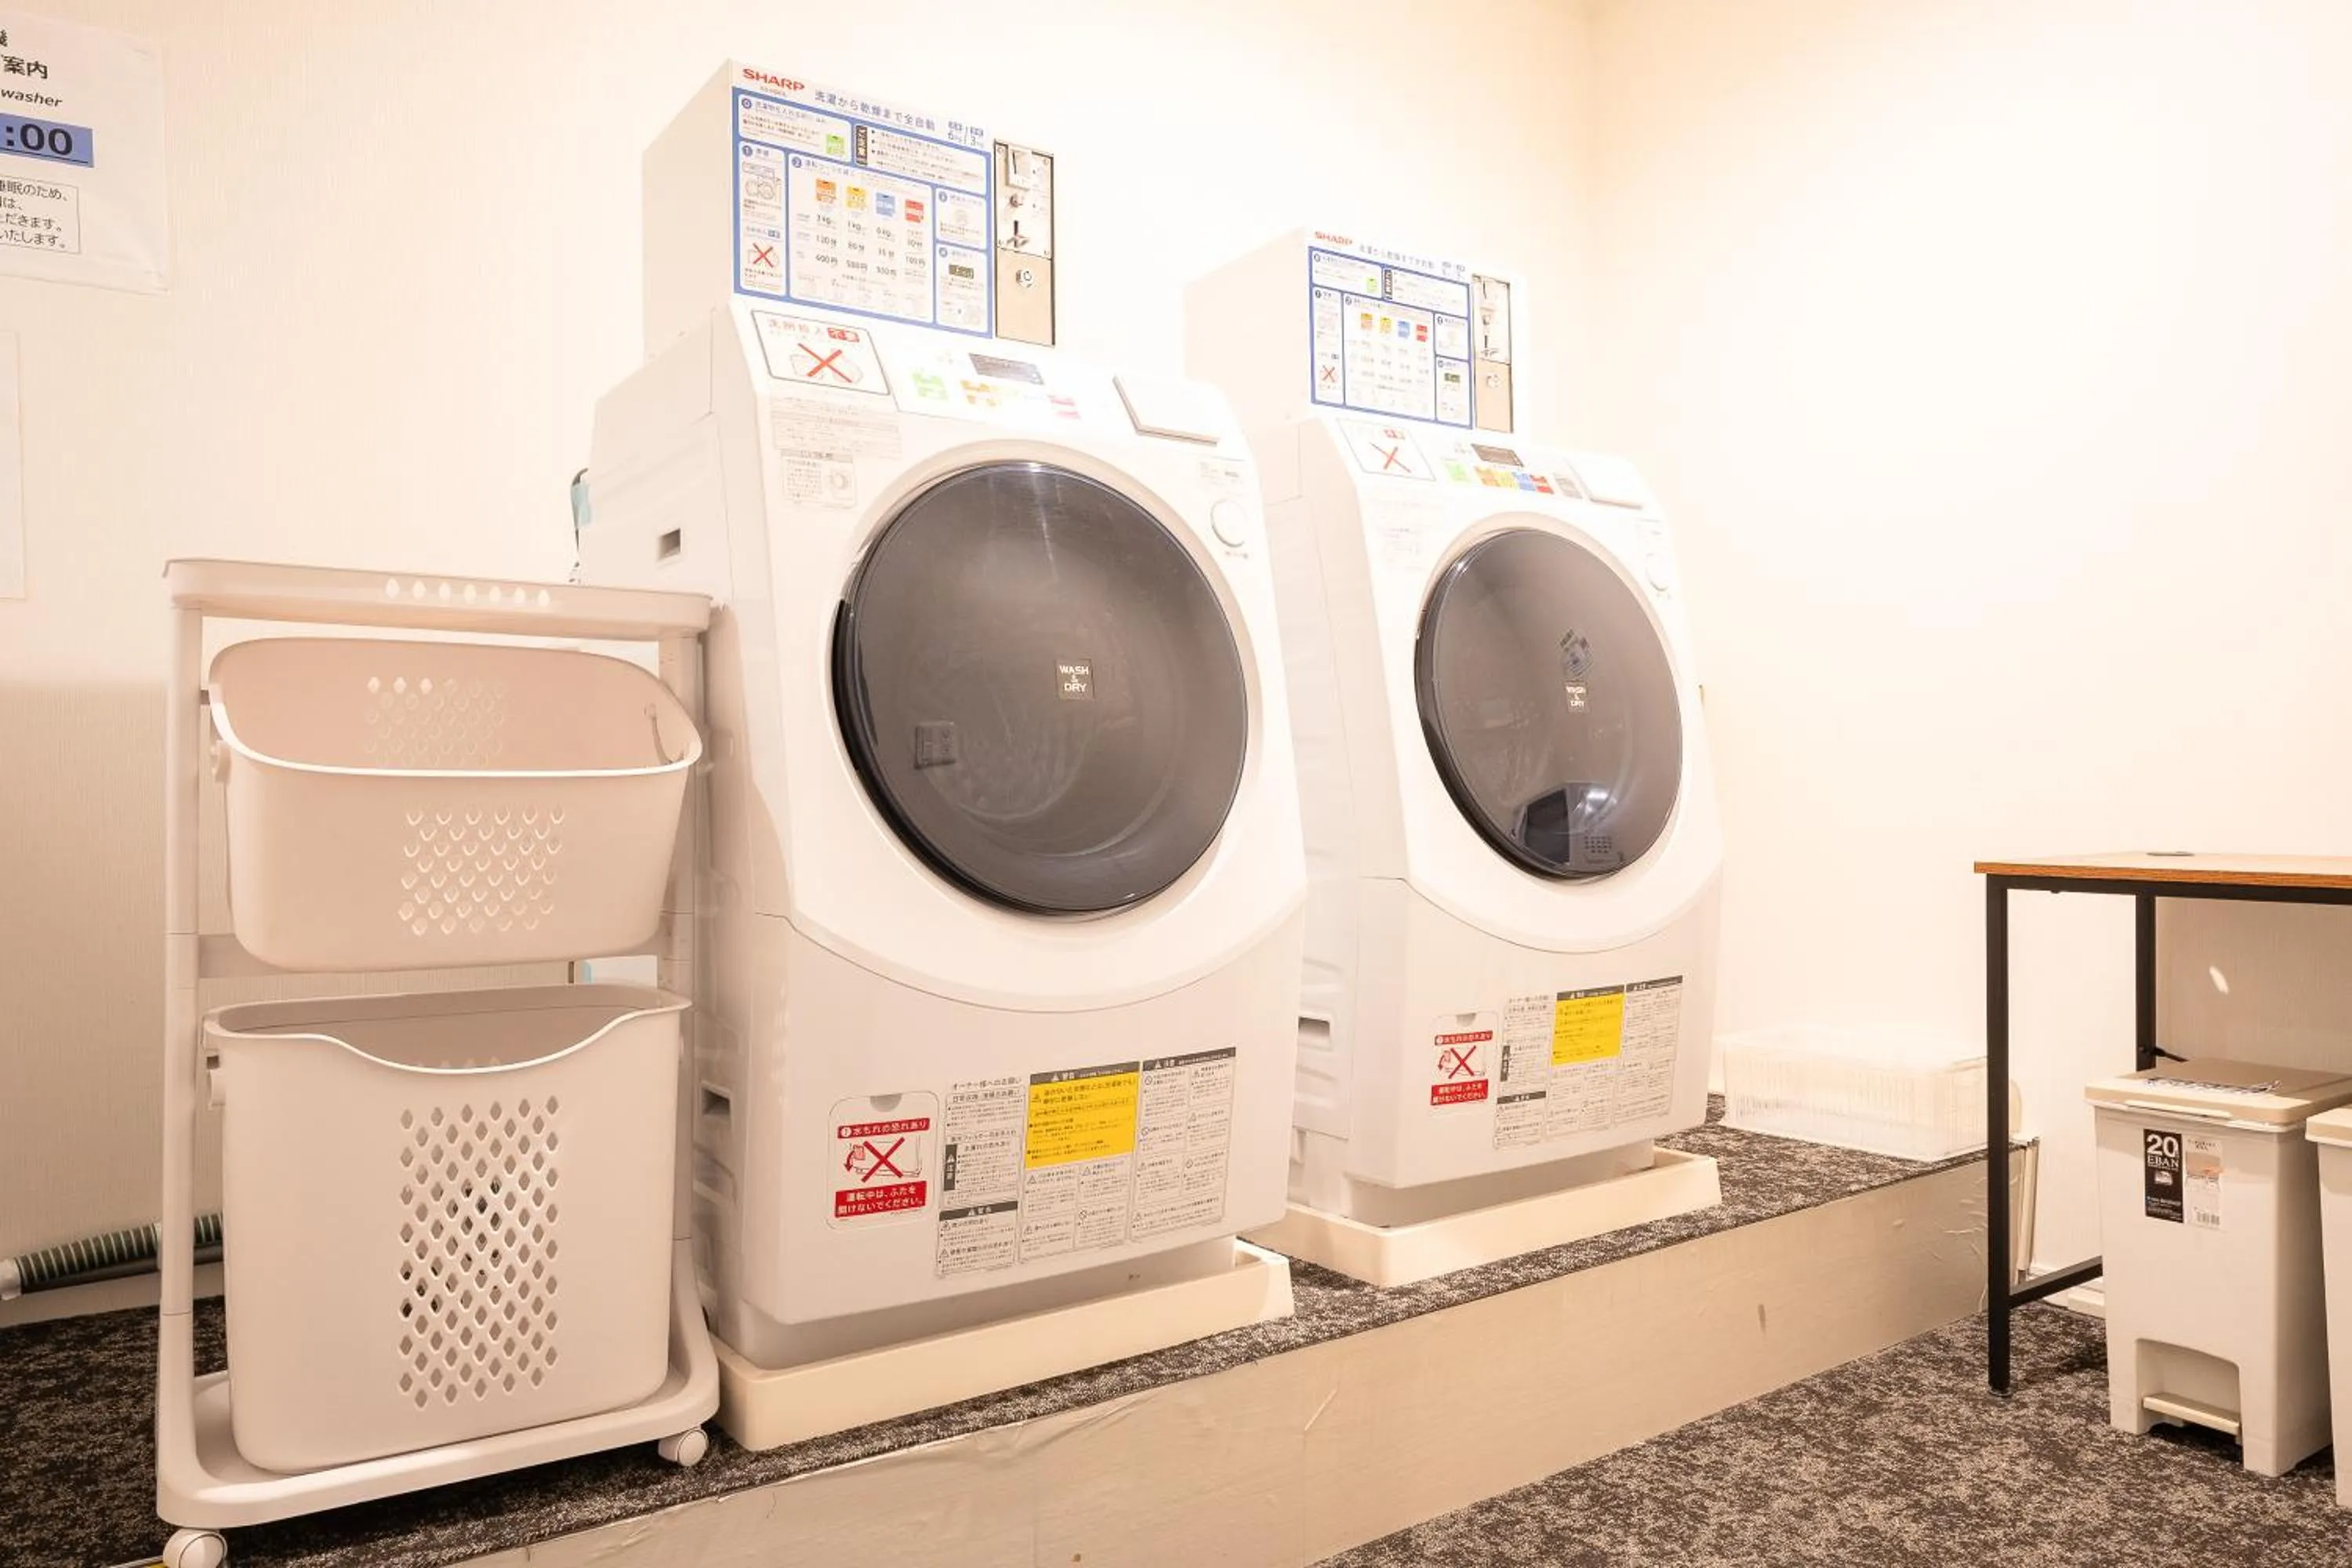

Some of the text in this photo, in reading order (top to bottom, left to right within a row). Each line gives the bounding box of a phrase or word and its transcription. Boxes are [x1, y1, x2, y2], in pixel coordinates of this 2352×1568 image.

[0, 54, 48, 79] 案内
[743, 68, 805, 91] SHARP
[1, 89, 63, 107] washer
[0, 213, 62, 233] だきます。
[1059, 665, 1089, 675] WASH
[1071, 674, 1079, 683] &
[1064, 683, 1087, 692] DRY
[853, 1120, 927, 1136] 水もれの恐れあり
[2147, 1134, 2179, 1158] 20
[2147, 1155, 2179, 1167] EBAN
[847, 1185, 916, 1202] 運転中は、ふたを
[838, 1198, 923, 1214] 開けないでください。
